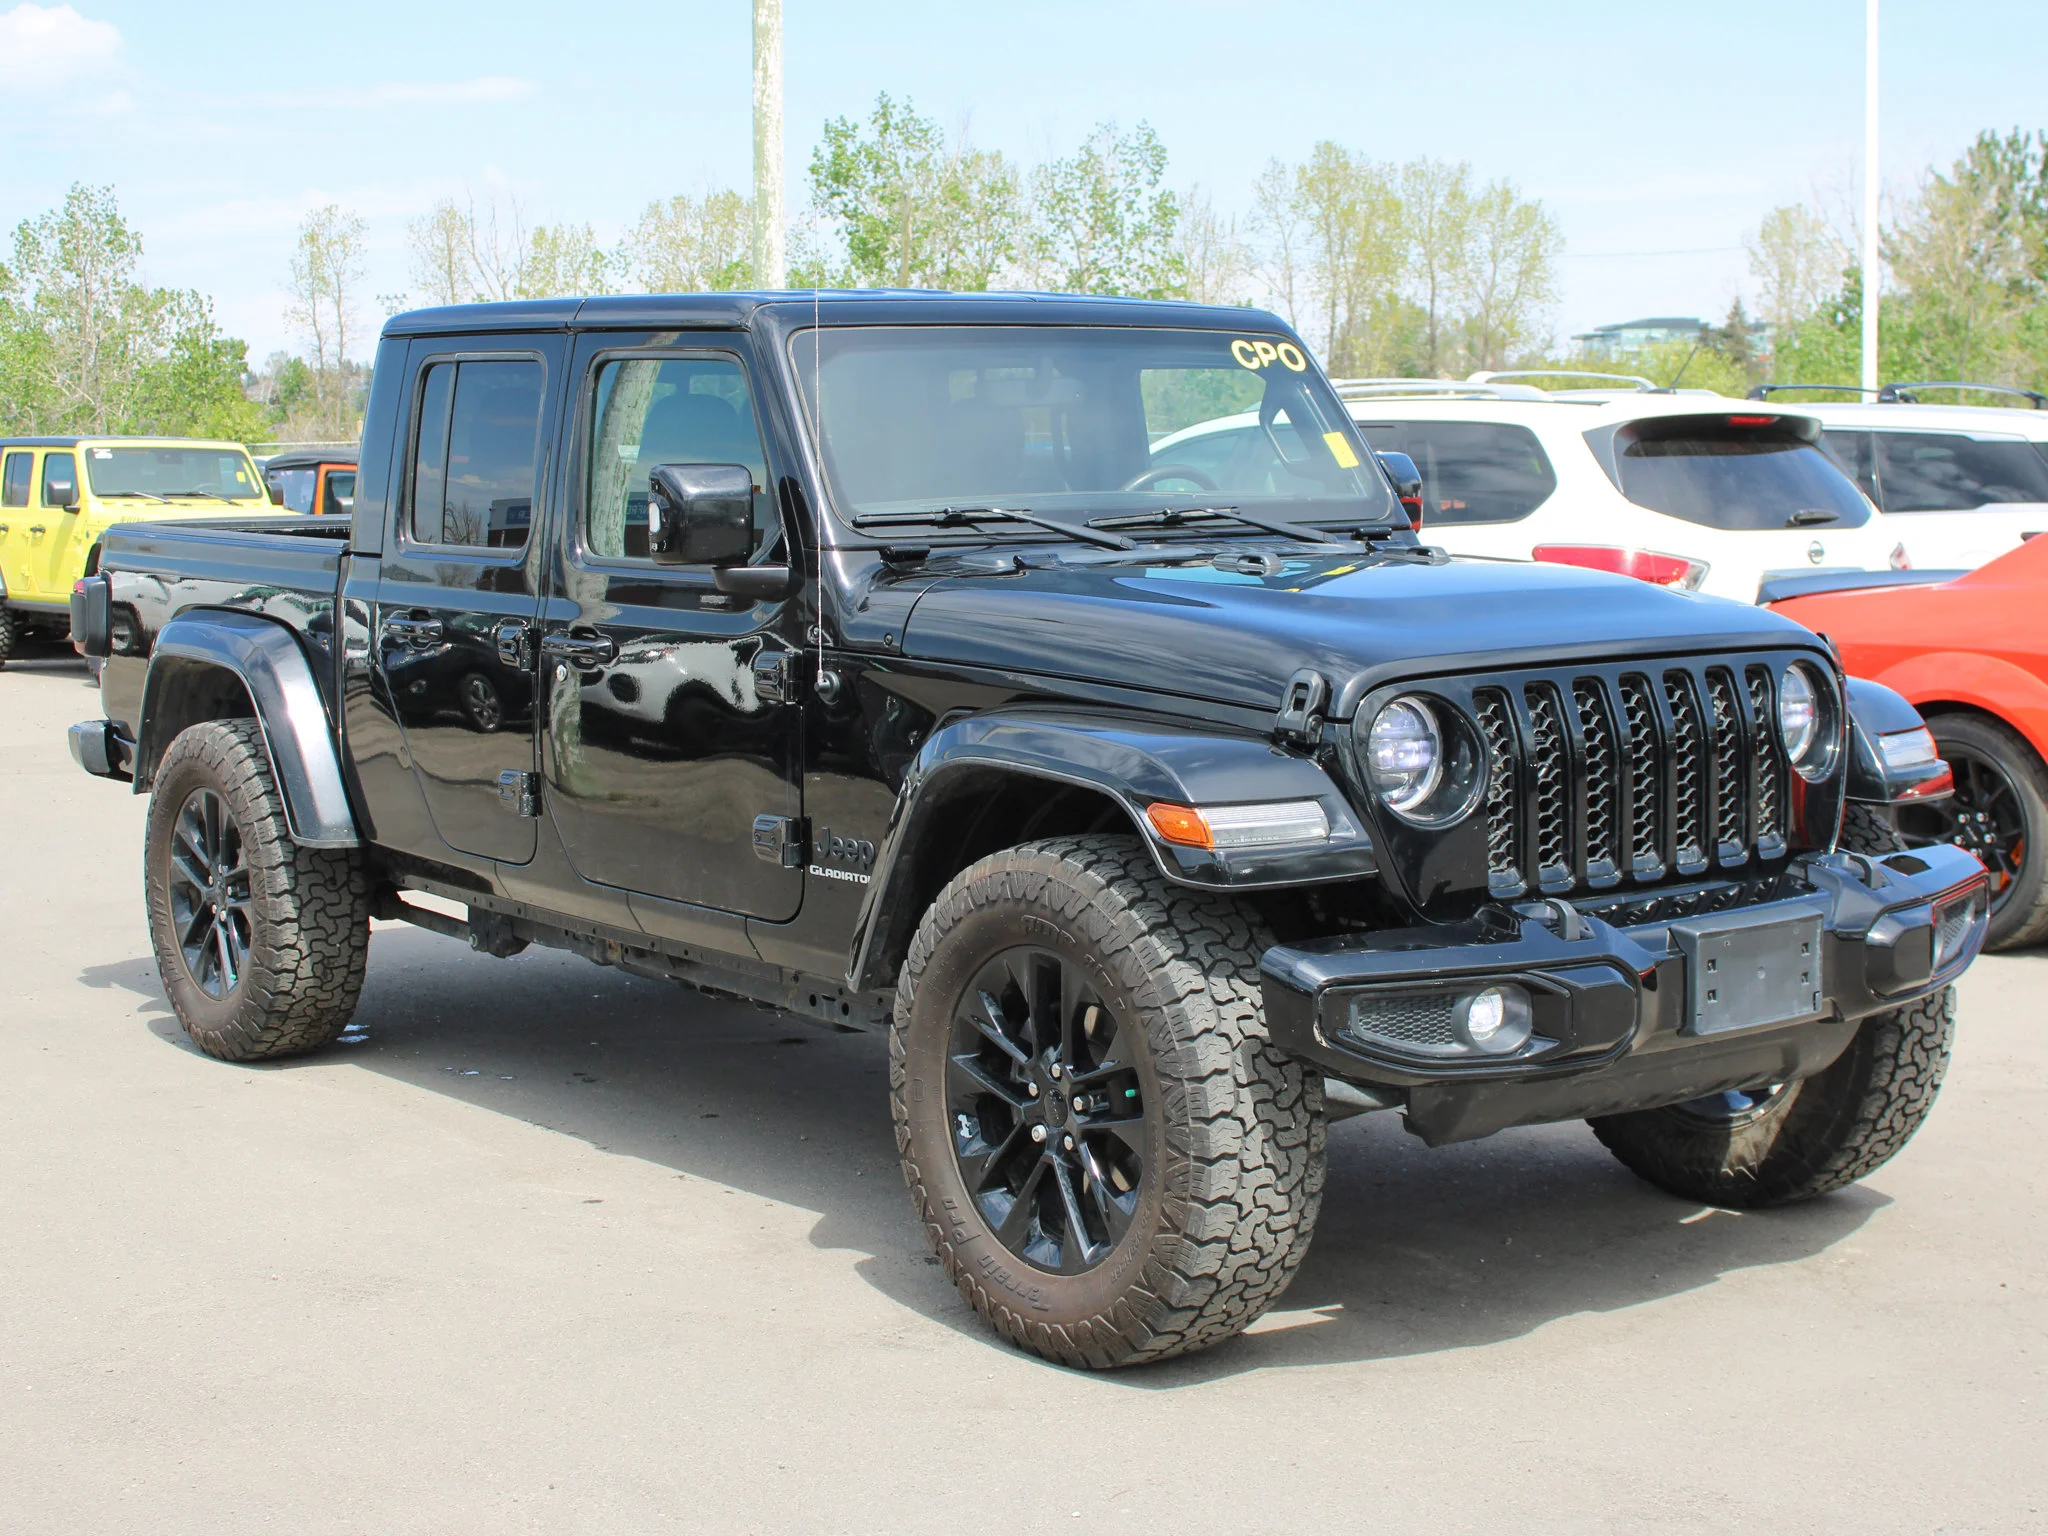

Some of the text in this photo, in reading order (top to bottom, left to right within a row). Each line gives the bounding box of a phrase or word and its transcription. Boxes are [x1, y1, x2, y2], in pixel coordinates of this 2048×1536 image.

[1231, 339, 1307, 372] CPO
[813, 826, 876, 871] Jeep
[941, 1196, 1052, 1312] Terrain Pro
